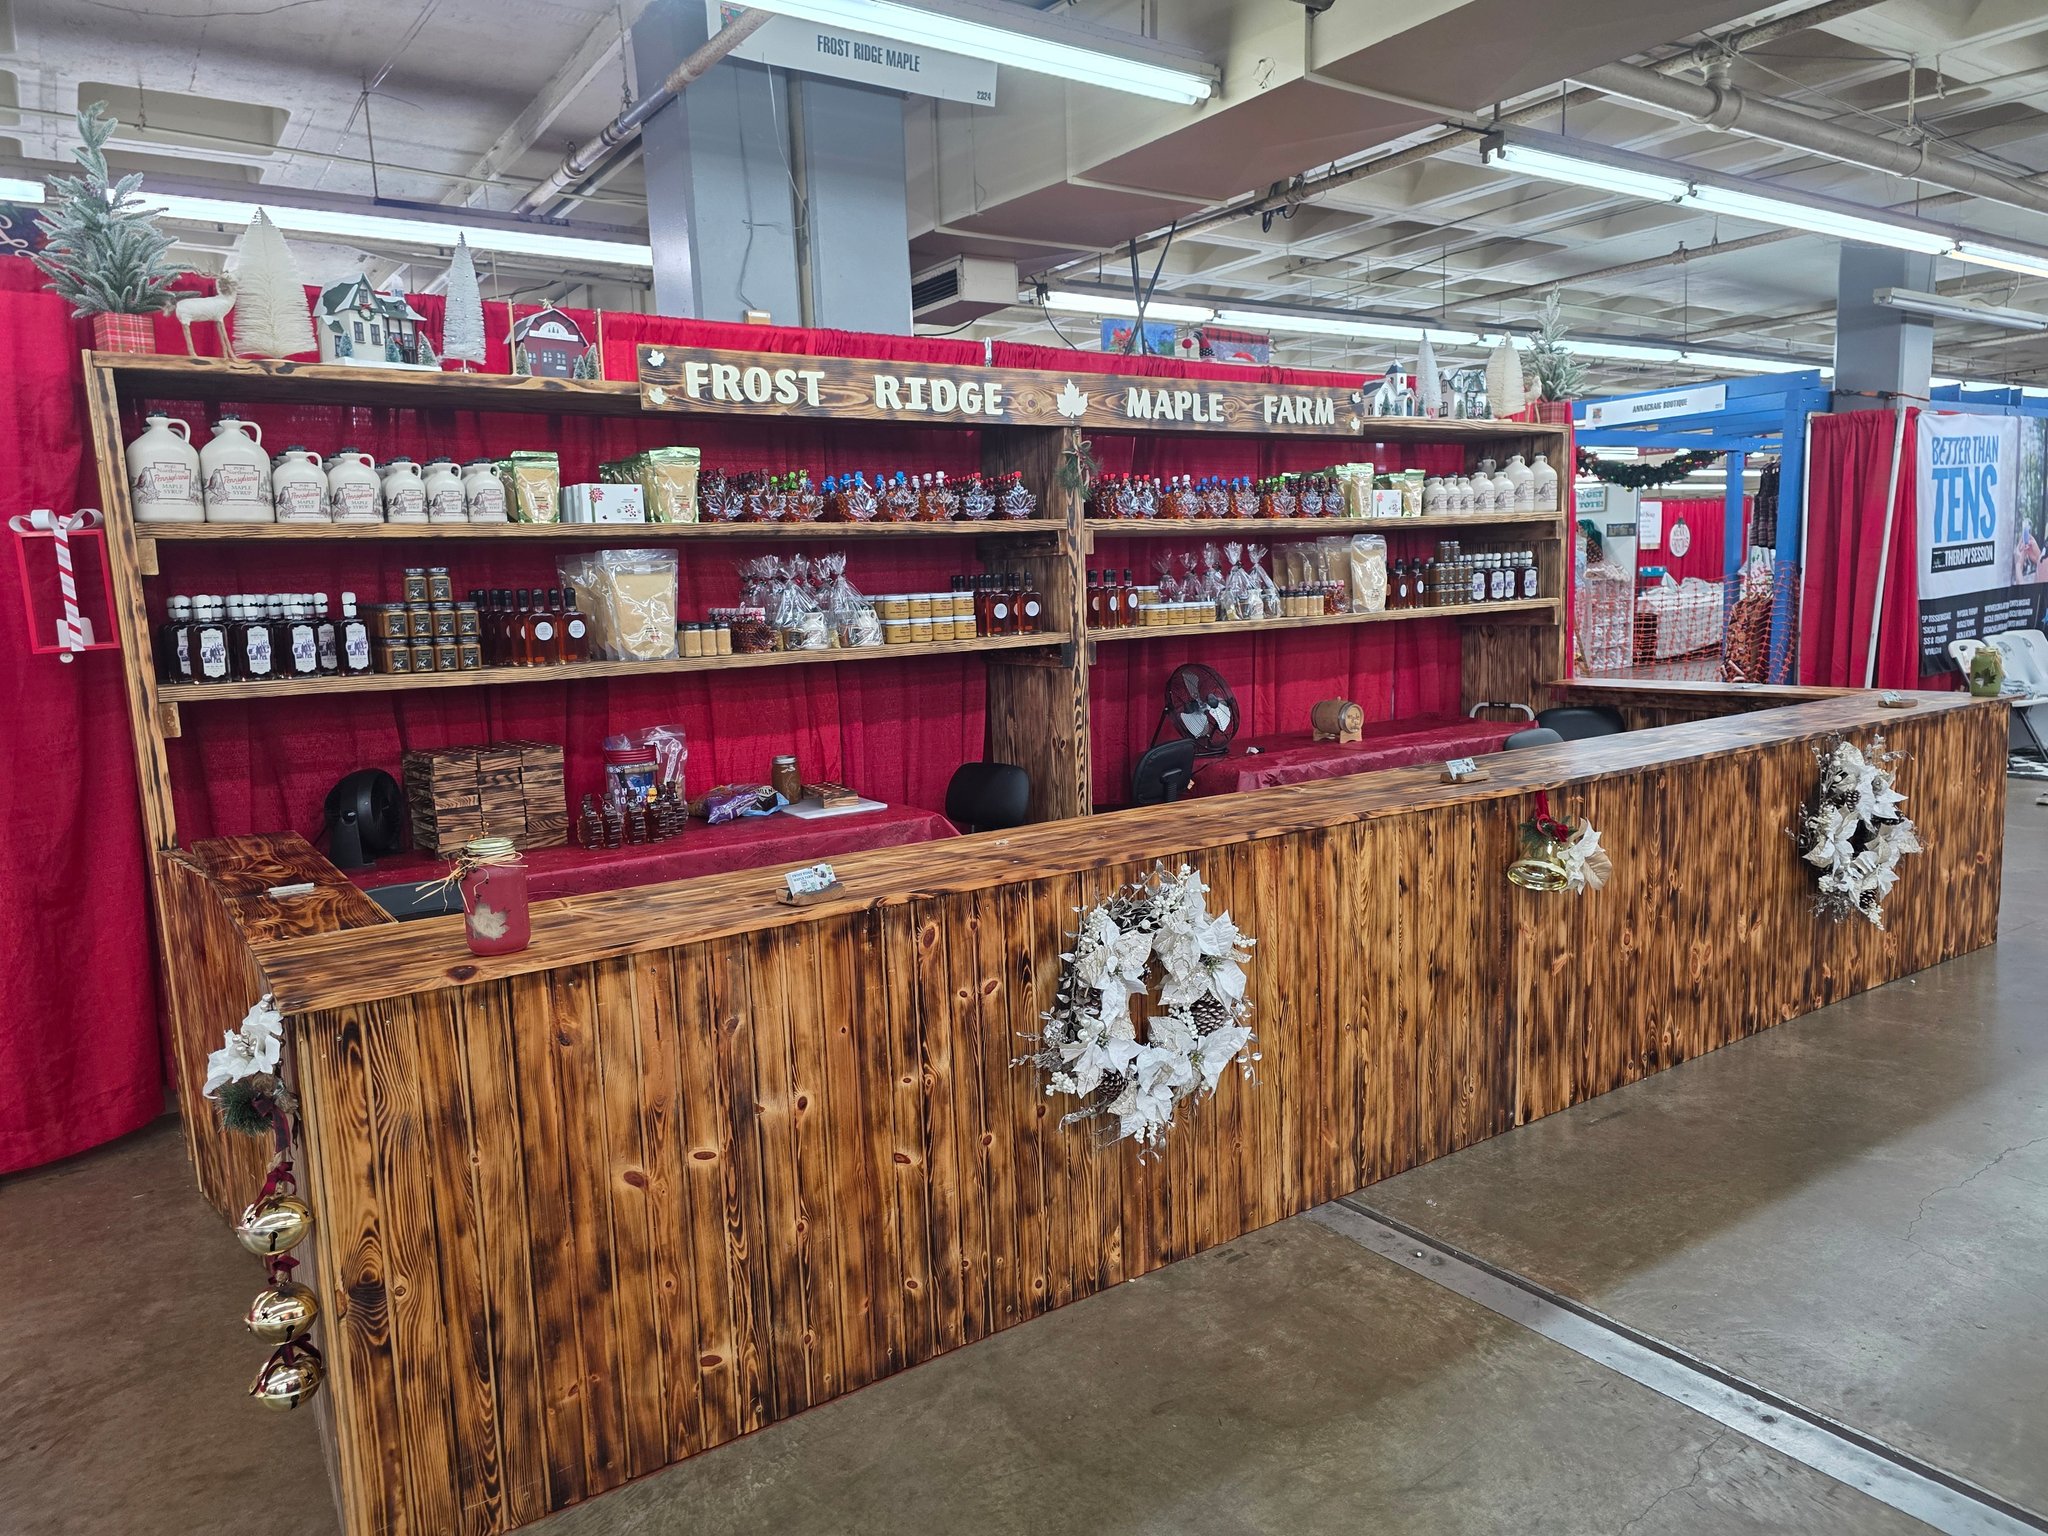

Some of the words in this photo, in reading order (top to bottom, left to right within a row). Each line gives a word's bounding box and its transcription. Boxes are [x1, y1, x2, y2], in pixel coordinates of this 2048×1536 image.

[817, 35, 850, 57] FROST
[854, 42, 883, 64] RIDGE
[886, 49, 920, 72] MAPLE
[684, 362, 826, 407] FROST
[873, 374, 1003, 416] RIDGE
[1126, 387, 1225, 422] MAPLE
[1264, 395, 1335, 425] FARM
[1663, 398, 1688, 409] BOUTIQUE
[1932, 437, 1971, 465] BETTER
[1973, 436, 1998, 464] THAN
[1932, 464, 1997, 543] TENS
[1945, 548, 1970, 566] THERAPY
[1971, 545, 1993, 563] SESSION
[622, 784, 651, 795] HPPY
